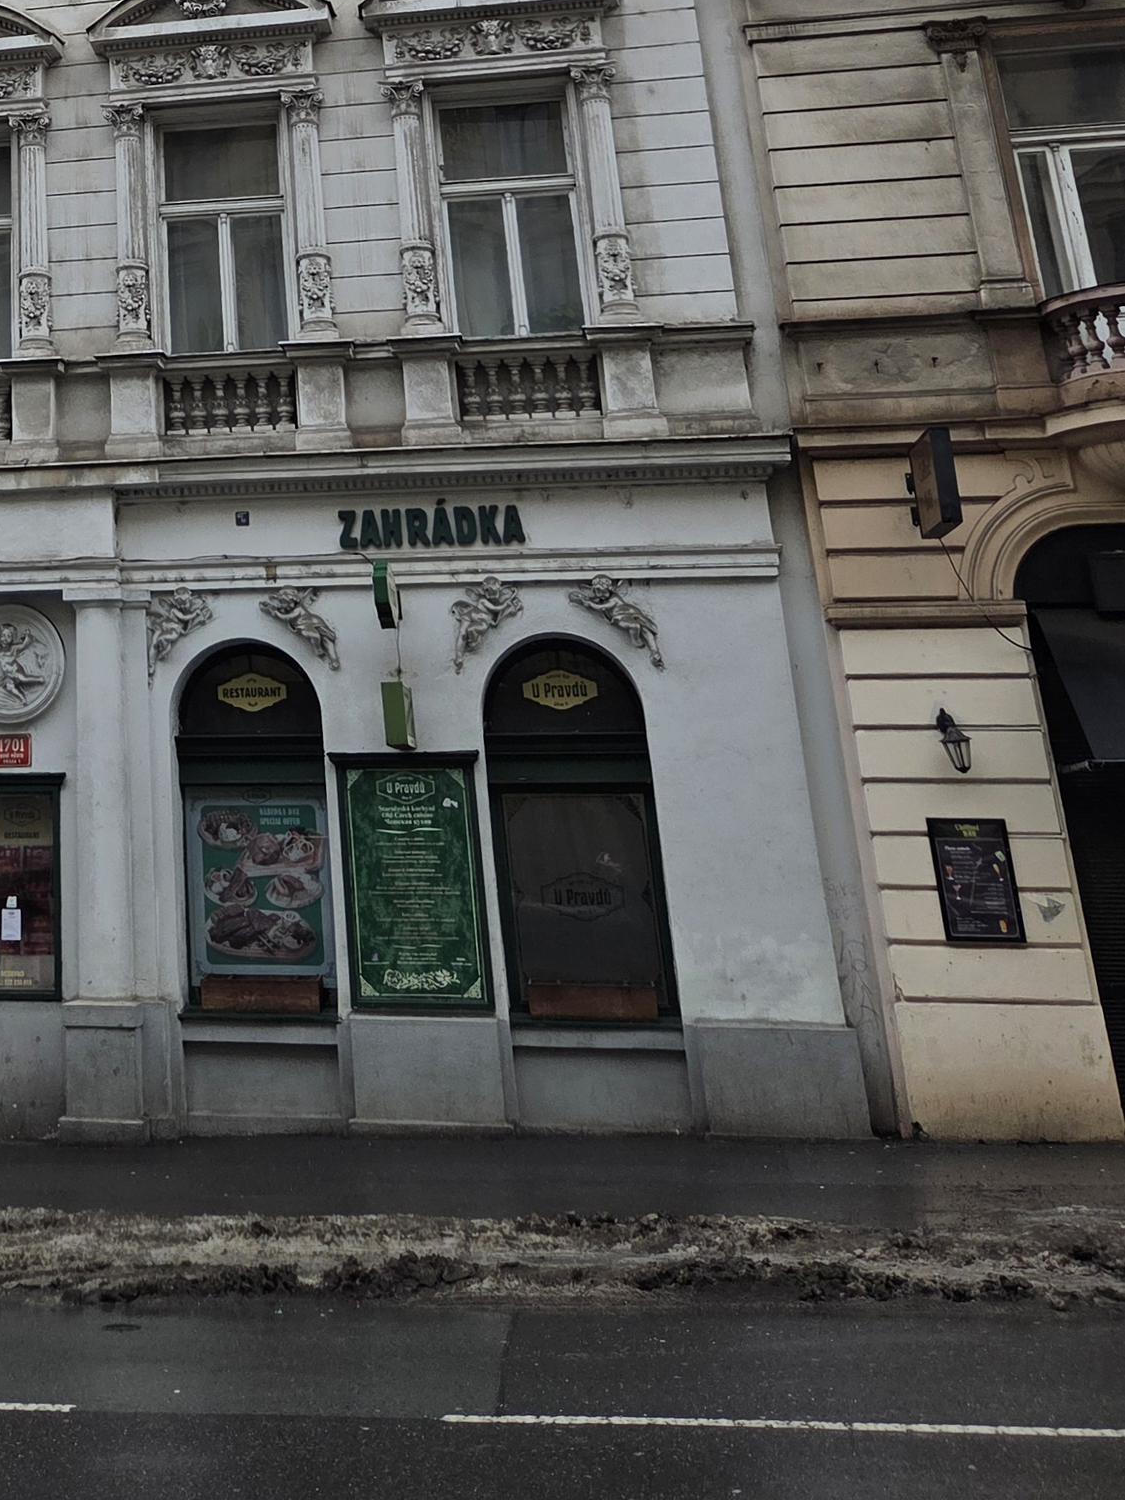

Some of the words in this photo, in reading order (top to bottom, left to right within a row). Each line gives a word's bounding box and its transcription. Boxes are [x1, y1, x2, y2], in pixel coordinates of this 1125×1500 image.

[338, 498, 526, 549] ZAHRÁDKA
[222, 686, 282, 698] RESTAURANT
[531, 682, 540, 698] U
[543, 680, 587, 698] Pravdů
[0, 738, 25, 752] 1701
